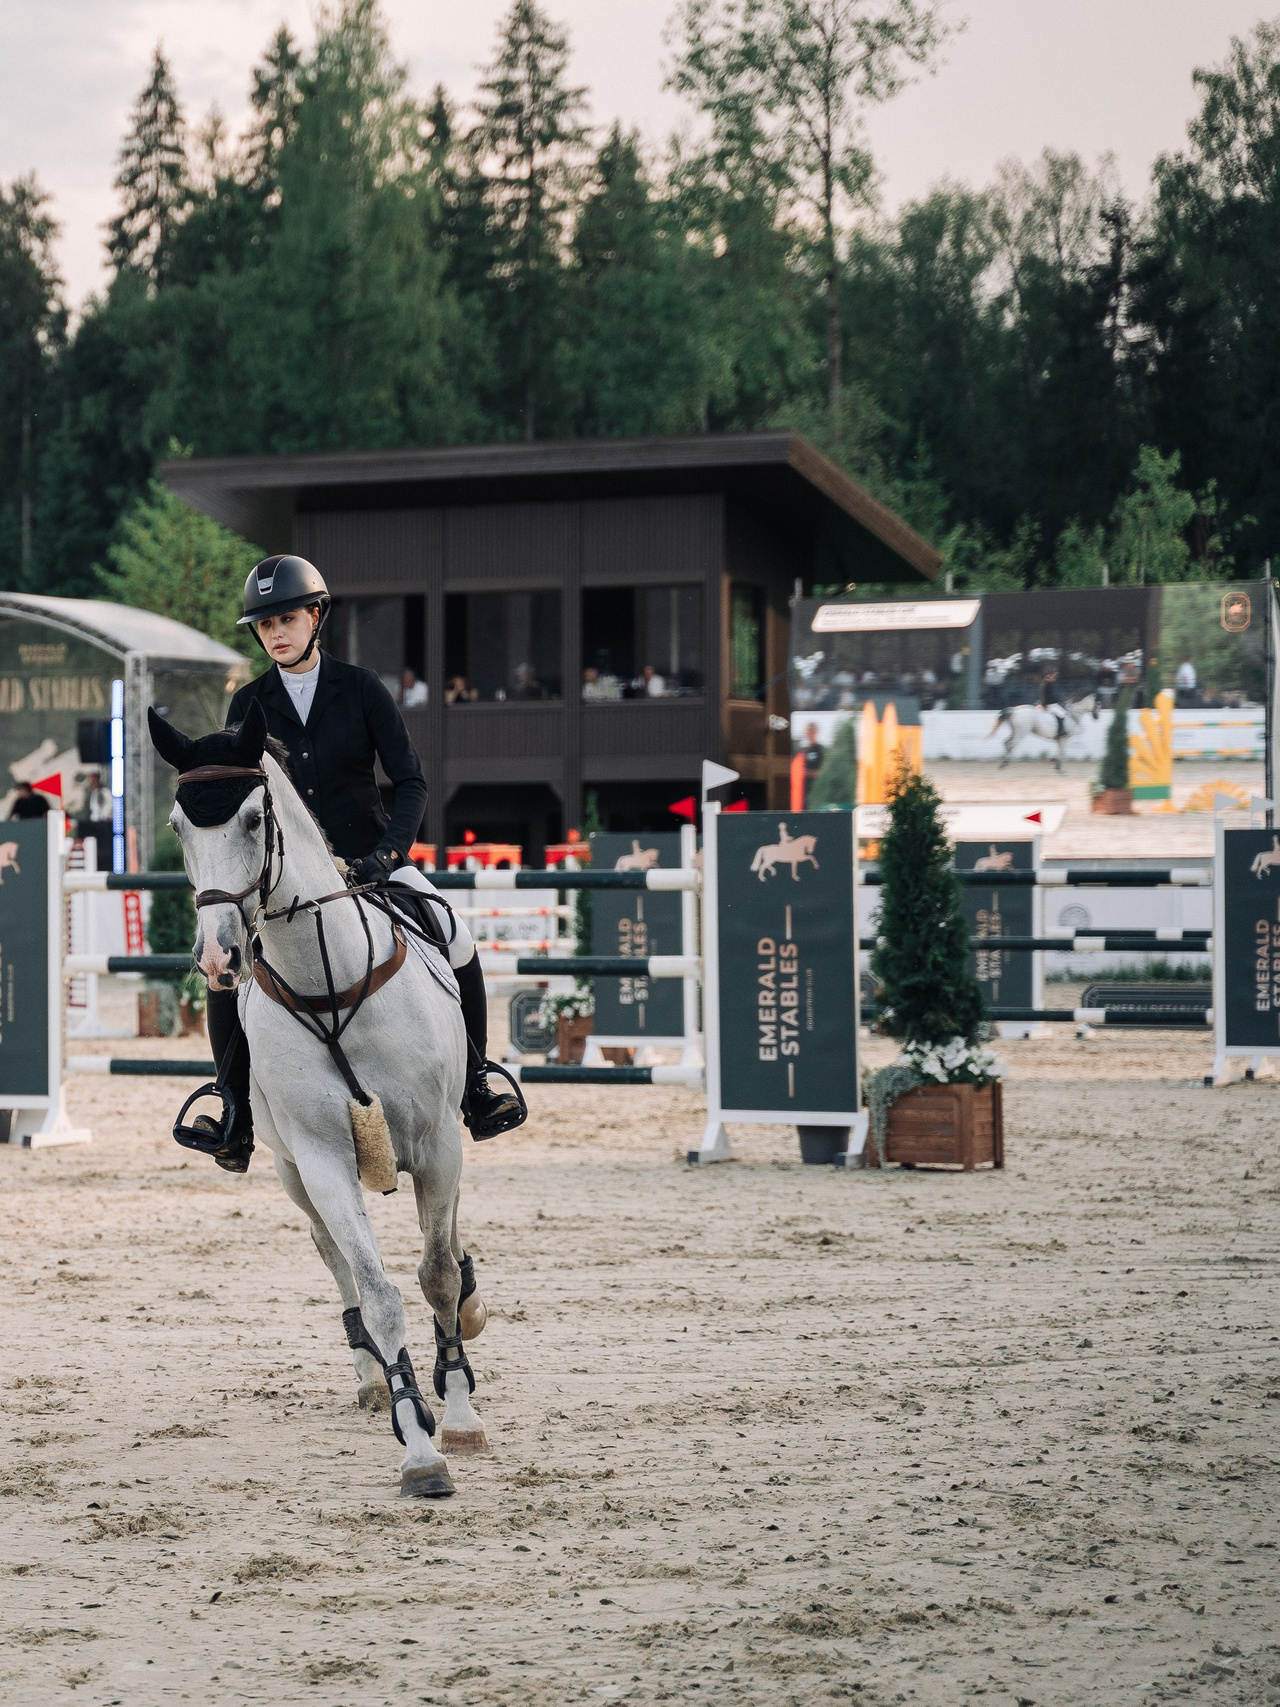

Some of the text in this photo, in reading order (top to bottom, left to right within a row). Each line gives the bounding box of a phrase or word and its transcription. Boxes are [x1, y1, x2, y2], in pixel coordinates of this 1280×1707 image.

[618, 917, 634, 1004] EMALD
[757, 937, 778, 1062] EMERALD
[779, 942, 800, 1057] STABLES
[1255, 919, 1270, 1012] EMERALD
